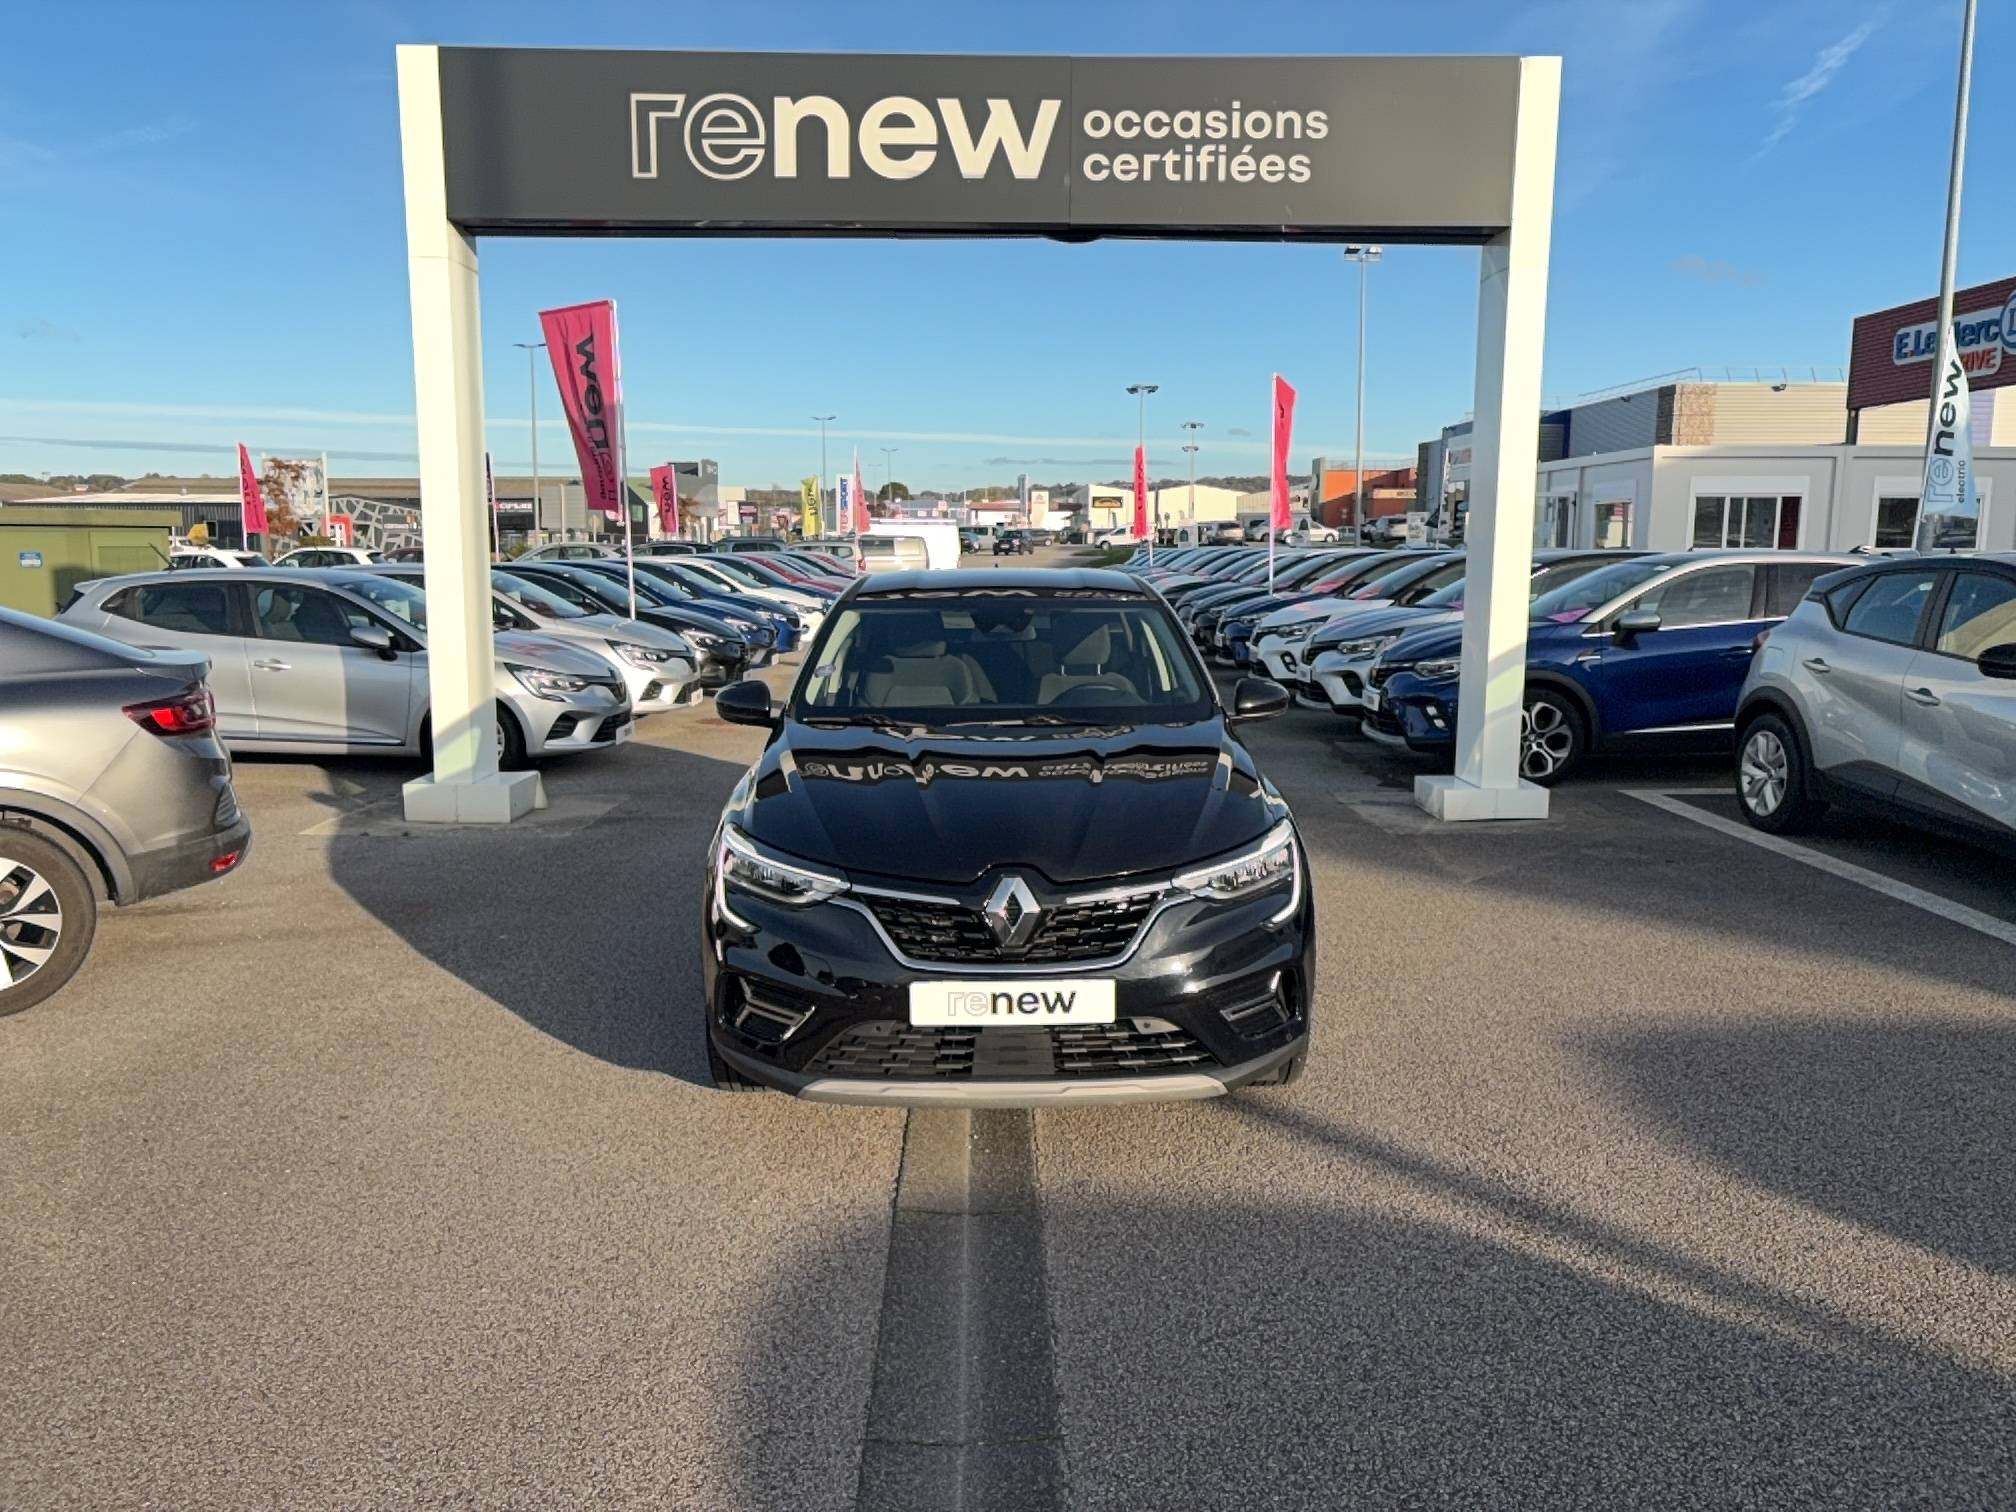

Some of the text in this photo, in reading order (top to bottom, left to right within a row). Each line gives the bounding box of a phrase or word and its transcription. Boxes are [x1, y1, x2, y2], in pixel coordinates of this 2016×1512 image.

[630, 93, 1062, 180] renew
[1083, 101, 1329, 139] occasions
[1083, 144, 1312, 183] certifiées
[1895, 318, 2000, 360] E.Lelerc
[1927, 358, 1963, 503] renew
[948, 991, 1077, 1016] renew
